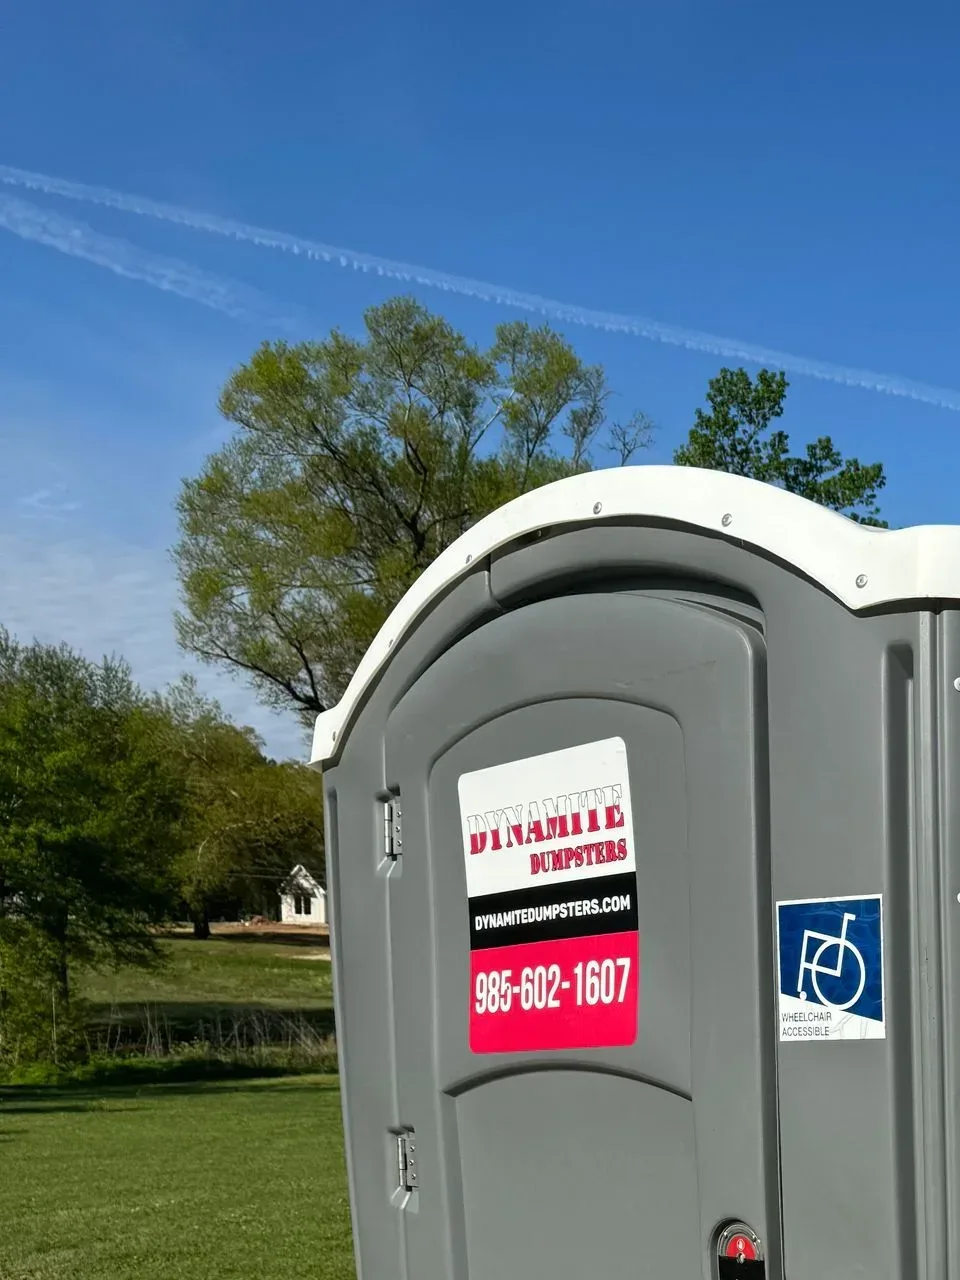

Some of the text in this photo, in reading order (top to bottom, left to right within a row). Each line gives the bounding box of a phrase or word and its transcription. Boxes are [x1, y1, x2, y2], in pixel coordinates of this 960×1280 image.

[467, 784, 624, 855] DYNAMITE
[530, 838, 627, 875] DUMPSTERS
[475, 894, 631, 930] DYNAMITEDUMPSTERS.COM
[475, 957, 631, 1014] 985-602-1607
[781, 1011, 832, 1022] WHEELCHAIR
[782, 1026, 830, 1037] ACCESSIBLE
